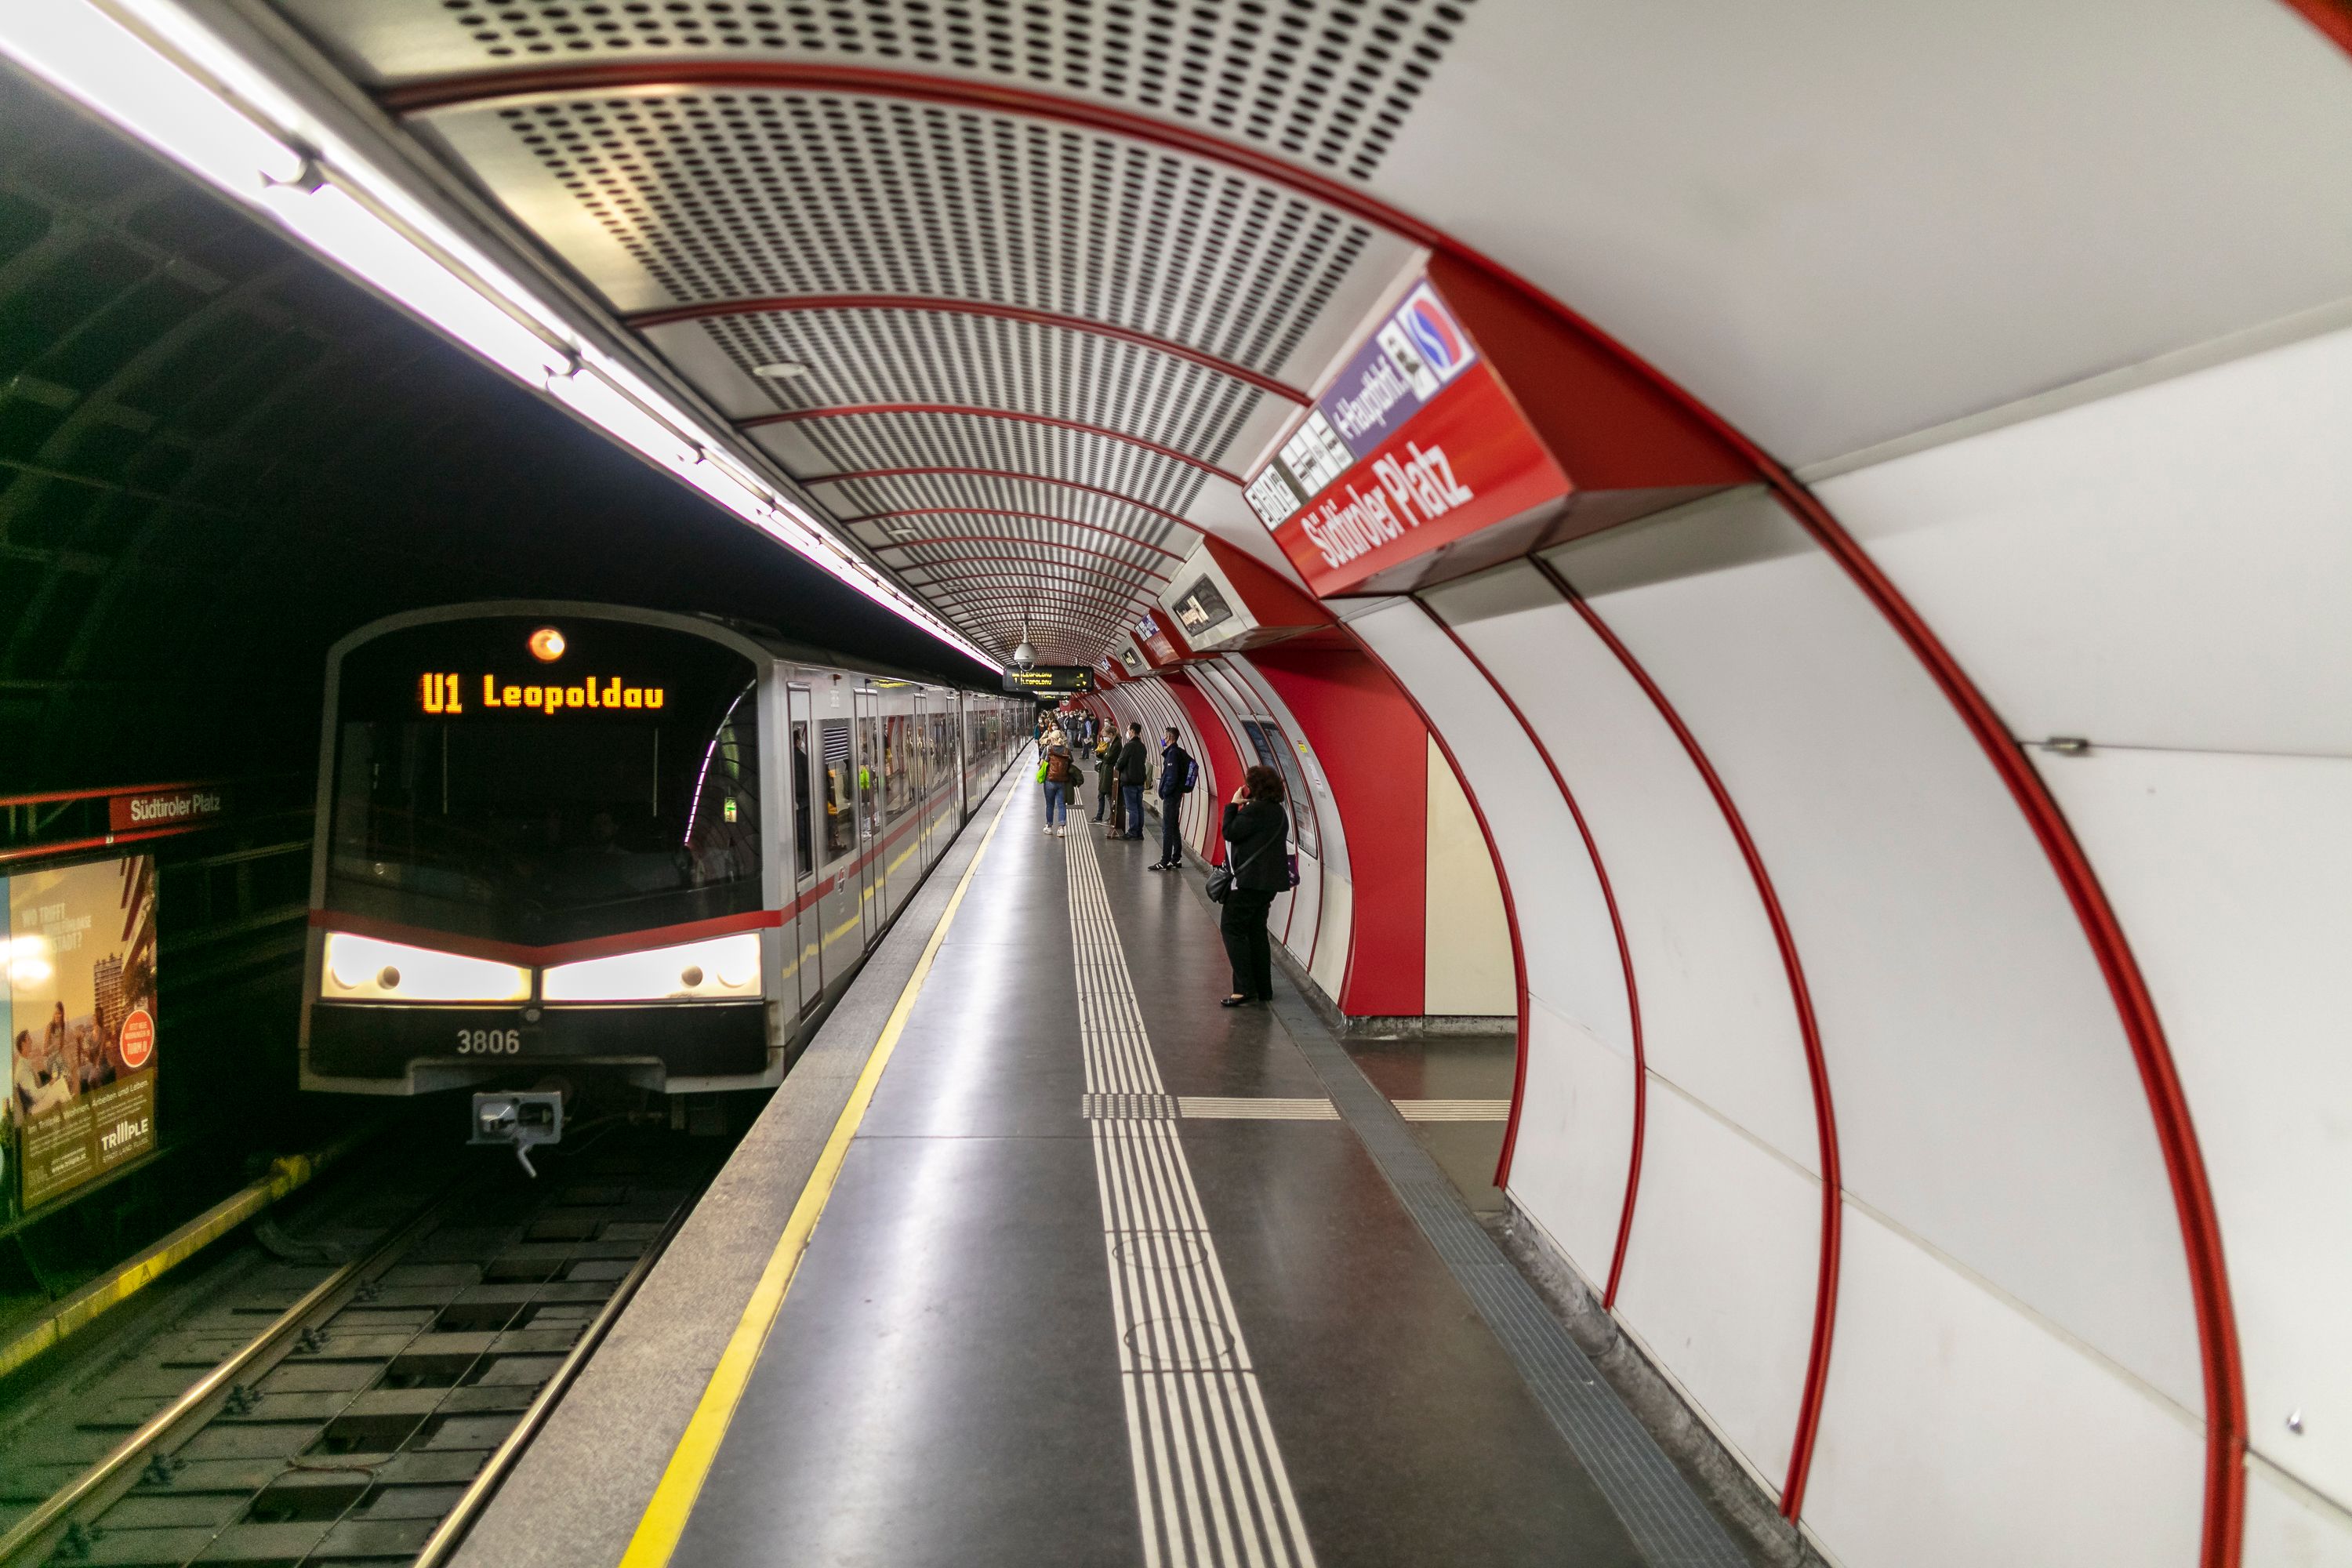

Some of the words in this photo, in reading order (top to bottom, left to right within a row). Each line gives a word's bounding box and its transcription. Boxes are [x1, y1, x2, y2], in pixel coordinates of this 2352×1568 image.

[1300, 484, 1406, 570] Südtiroler
[1372, 441, 1474, 528] Platz
[422, 673, 463, 714] U1
[482, 673, 664, 715] Leopoldau
[130, 796, 191, 821] Südtiroler
[193, 793, 220, 813] Platz
[456, 1029, 520, 1054] 3806
